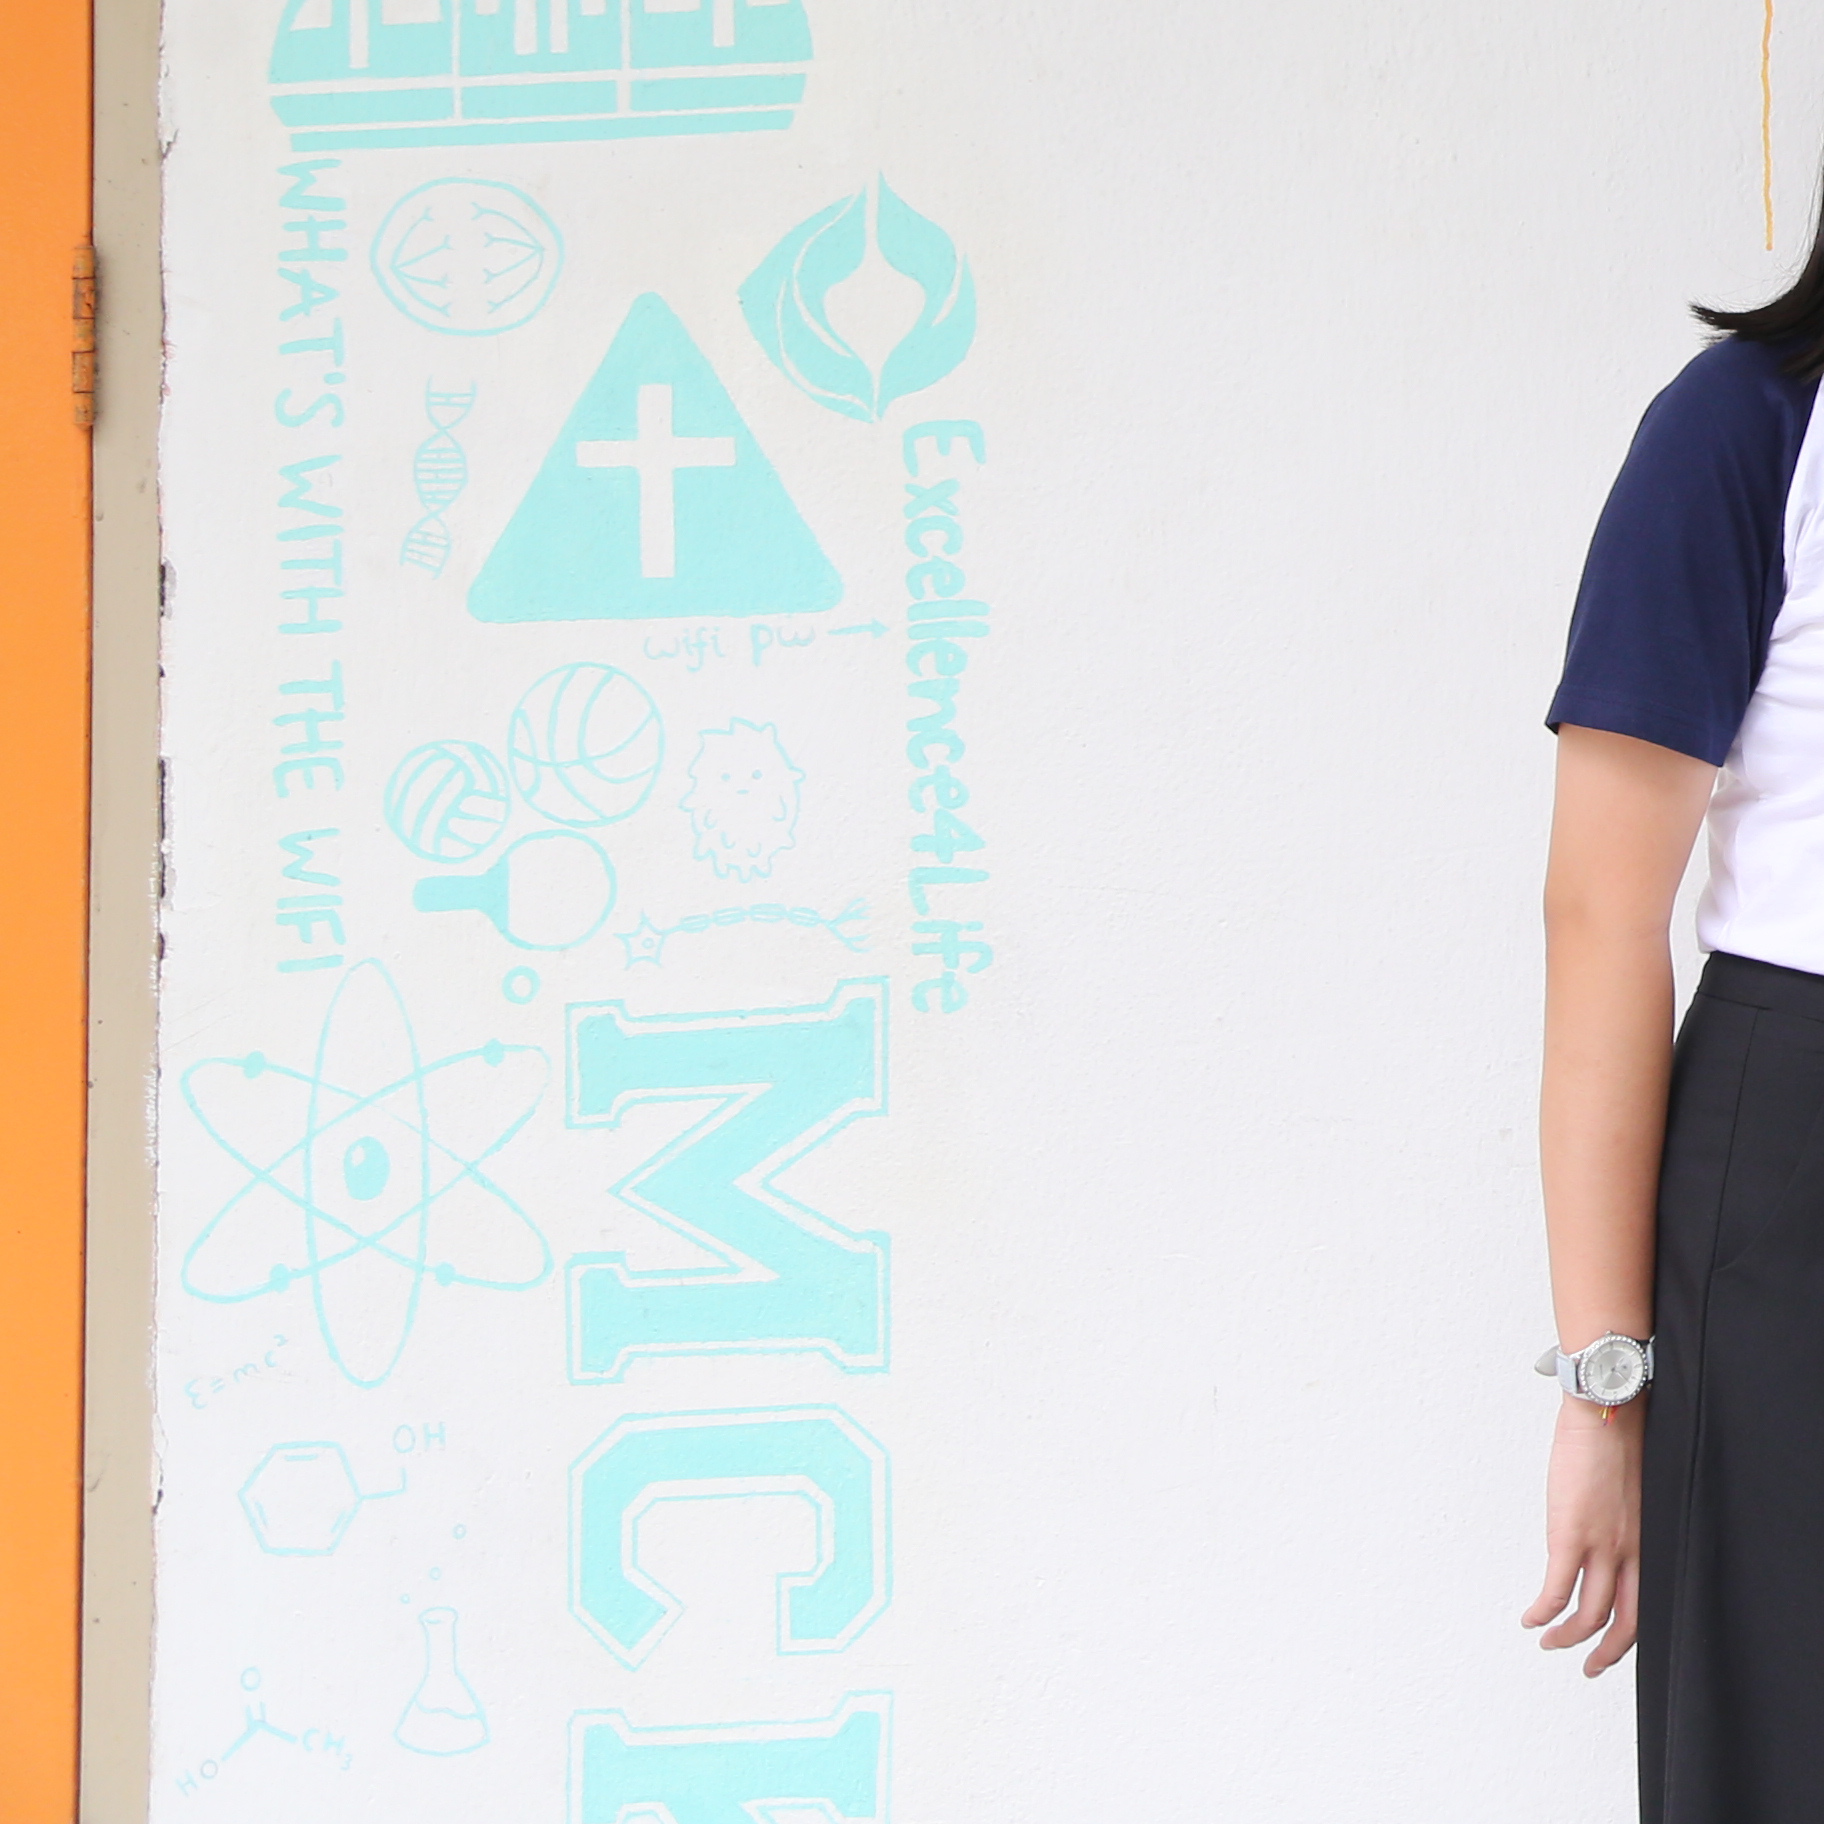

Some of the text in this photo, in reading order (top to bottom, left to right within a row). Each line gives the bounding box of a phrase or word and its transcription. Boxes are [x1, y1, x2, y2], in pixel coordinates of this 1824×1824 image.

[271, 158, 350, 974] WHAT'S WITH THE WIFI
[643, 623, 814, 673] wifi pw
[902, 419, 995, 1014] Excellence4Life
[393, 1422, 447, 1454] OH
